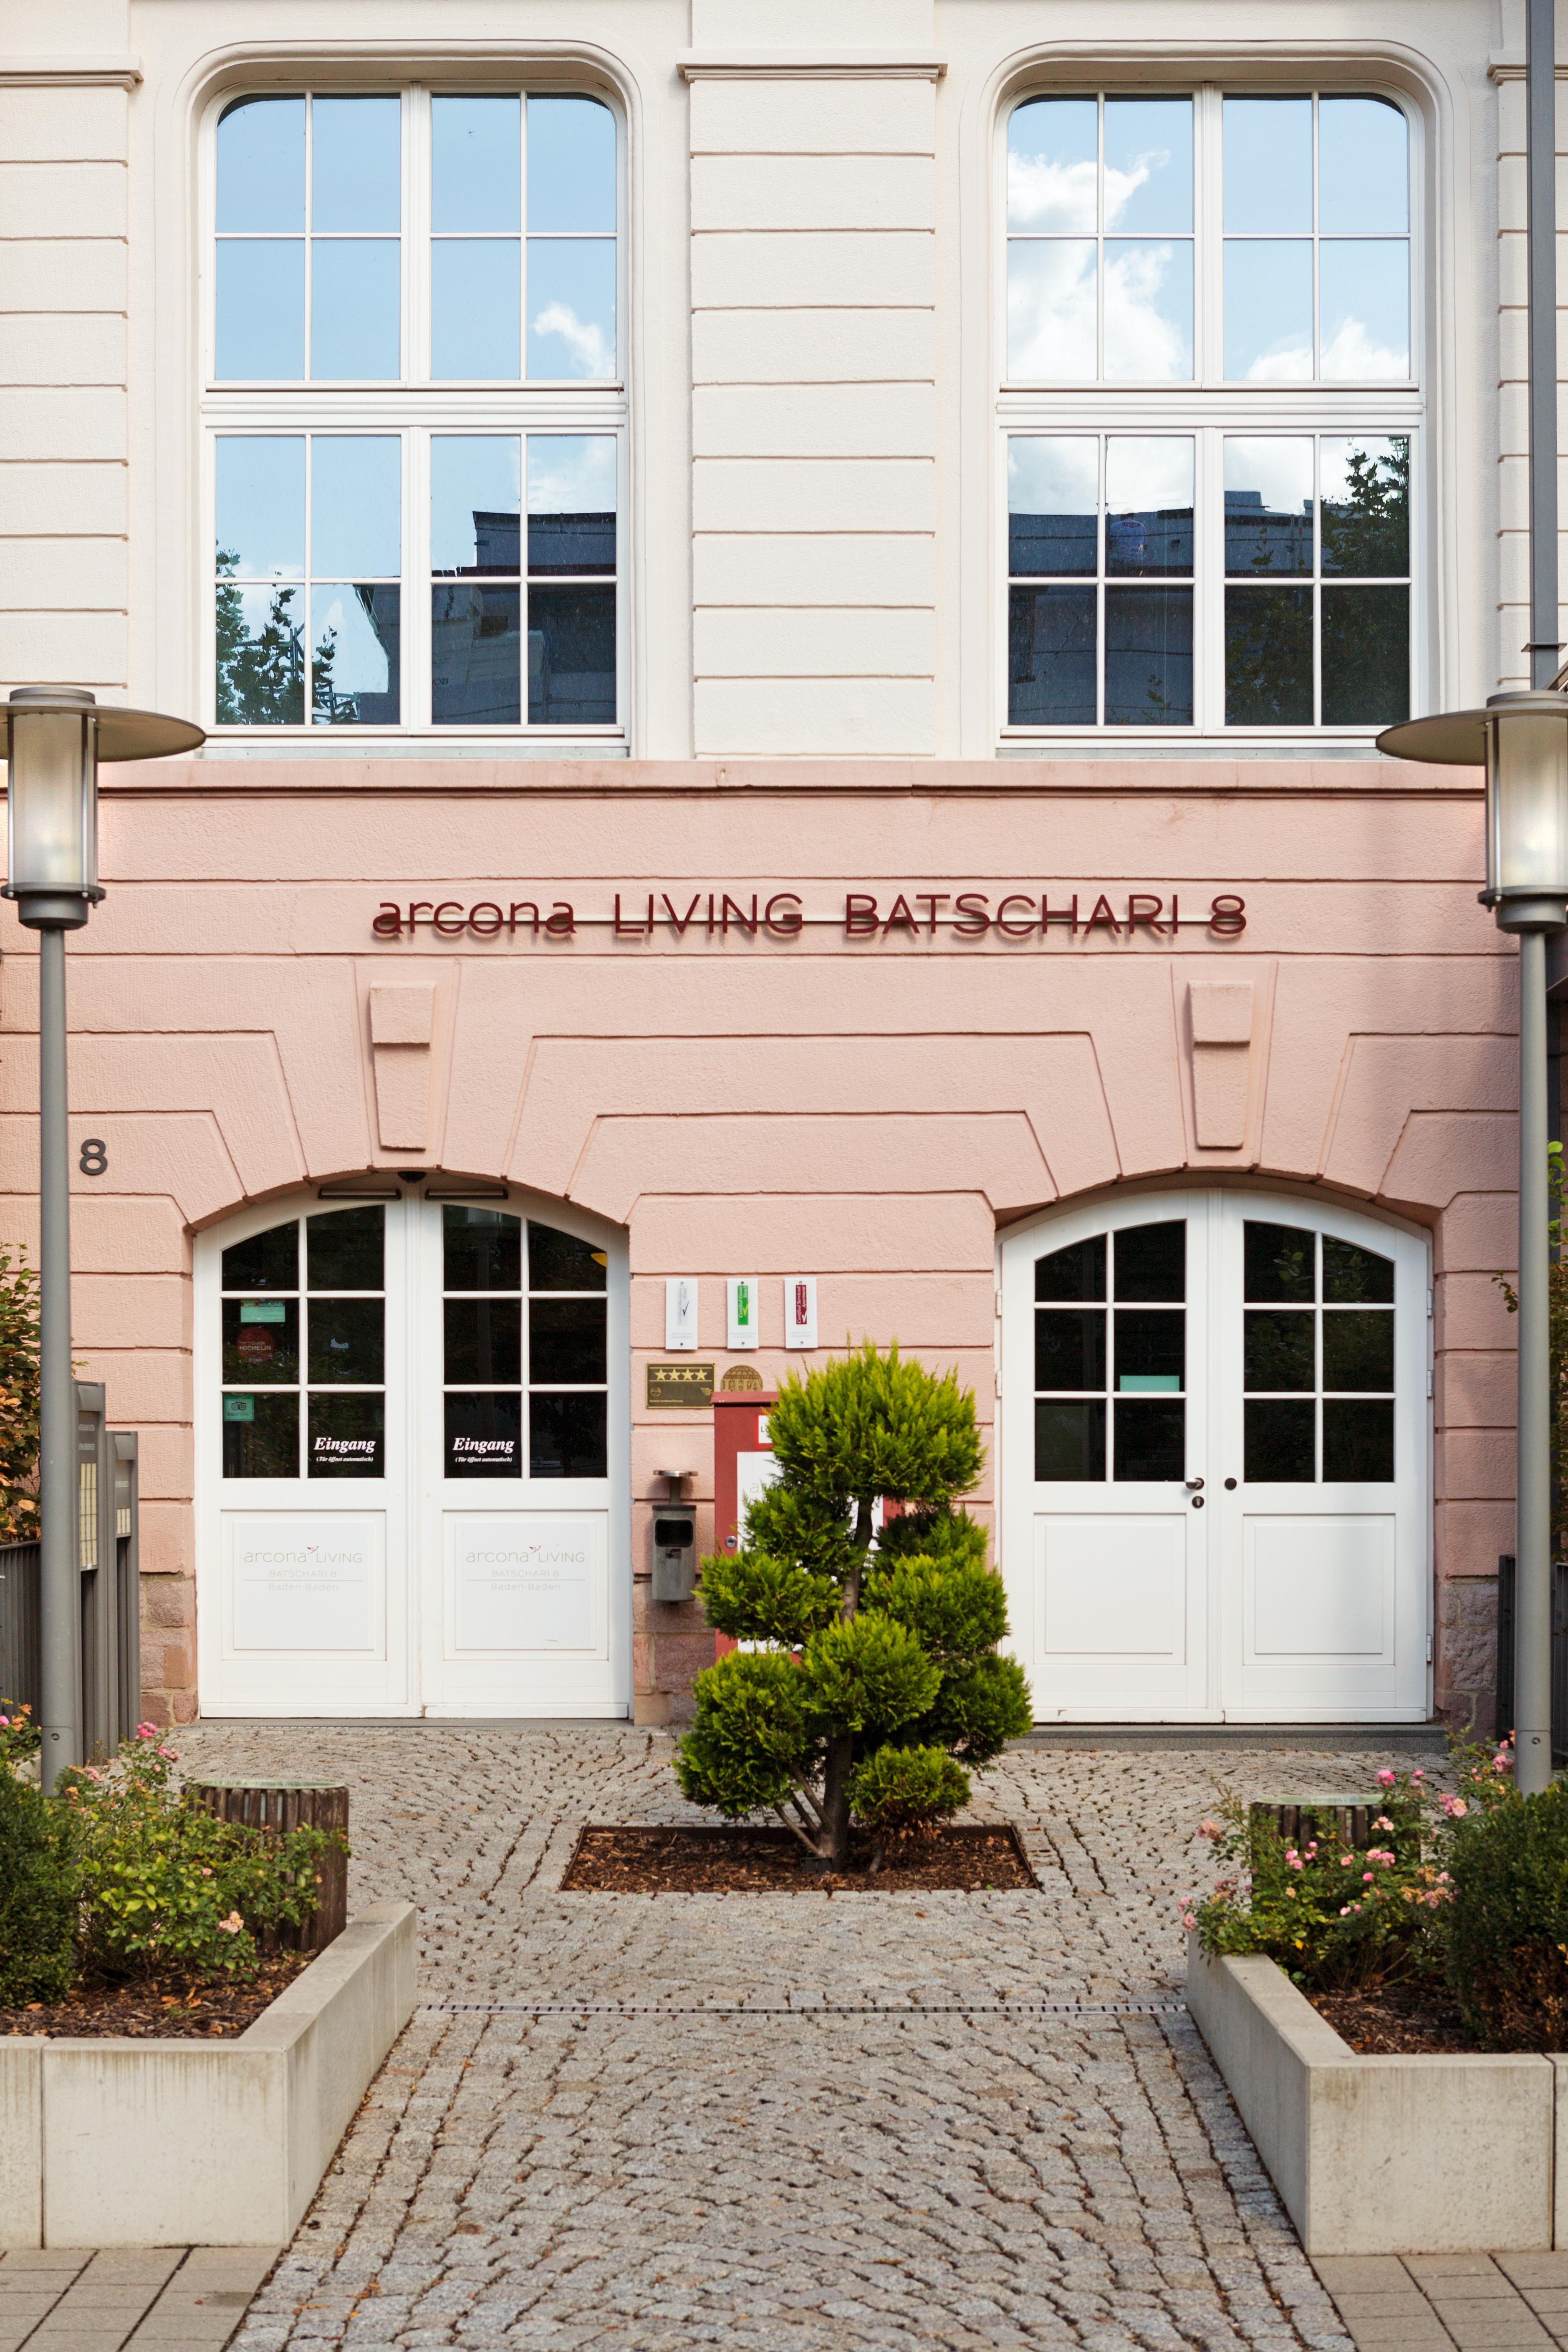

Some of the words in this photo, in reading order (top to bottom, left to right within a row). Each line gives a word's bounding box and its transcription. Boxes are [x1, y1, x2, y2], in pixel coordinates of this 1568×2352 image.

[372, 902, 577, 934] arcona
[614, 893, 803, 934] LIVING
[846, 893, 1178, 936] BATSCHARI
[1209, 894, 1247, 935] 8
[80, 1138, 108, 1176] 8
[314, 1437, 376, 1454] Eingang
[452, 1437, 515, 1454] Eingang
[244, 1552, 307, 1562] arcona
[316, 1553, 363, 1563] LIVING
[466, 1552, 529, 1562] arcona
[538, 1552, 585, 1562] LIVING
